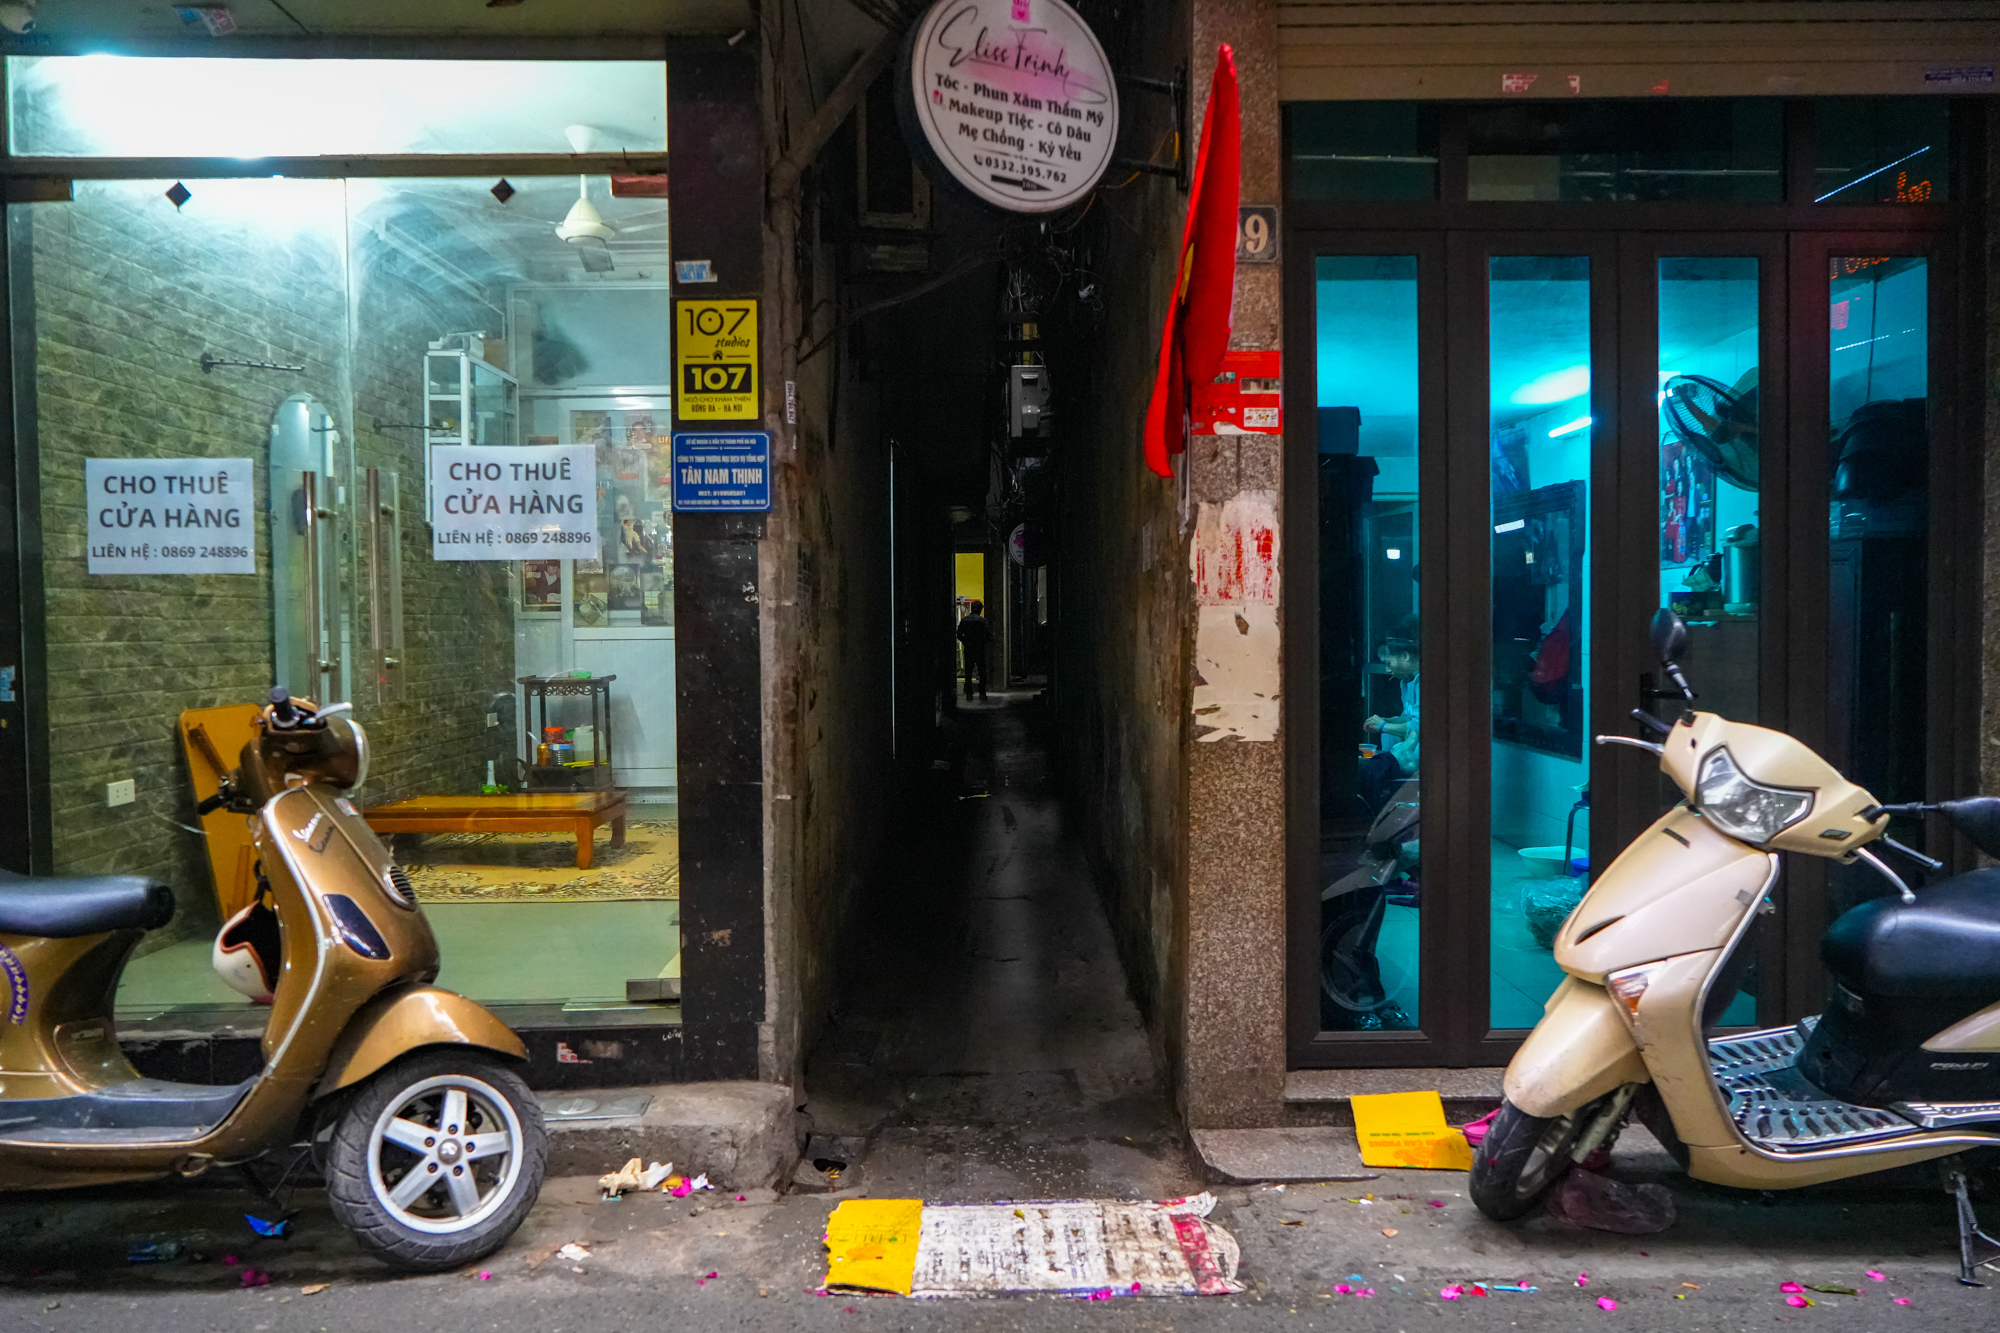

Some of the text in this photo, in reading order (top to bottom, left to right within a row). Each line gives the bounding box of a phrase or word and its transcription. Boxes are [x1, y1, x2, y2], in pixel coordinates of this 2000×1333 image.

[939, 5, 1009, 68] Eliss
[935, 73, 960, 92] Tóc
[974, 82, 1009, 103] Phun
[949, 98, 1003, 125] Makeup
[1007, 111, 1034, 131] Tiệc
[1047, 121, 1062, 135] Cô
[1067, 125, 1091, 142] Dâu
[959, 122, 978, 141] Mẹ
[985, 155, 1068, 184] 0332.395.762
[684, 307, 751, 336] 107
[715, 336, 751, 349] studios
[691, 366, 748, 391] 107
[449, 457, 572, 481] CHO THUÊ
[681, 465, 763, 488] TÂN NAM THỊNH
[103, 471, 229, 494] CHO THUÊ
[444, 488, 583, 514] CỬA HÀNG
[99, 501, 240, 528] CỬA HÀNG
[438, 530, 471, 544] LIÊN
[475, 530, 494, 547] HỆ
[505, 532, 539, 544] 0869
[542, 532, 592, 544] 248896
[92, 543, 126, 558] LIÊN
[131, 543, 150, 560] HỆ
[161, 546, 196, 558] 0869
[199, 546, 248, 558] 248896
[1368, 1140, 1402, 1148] PHONG
